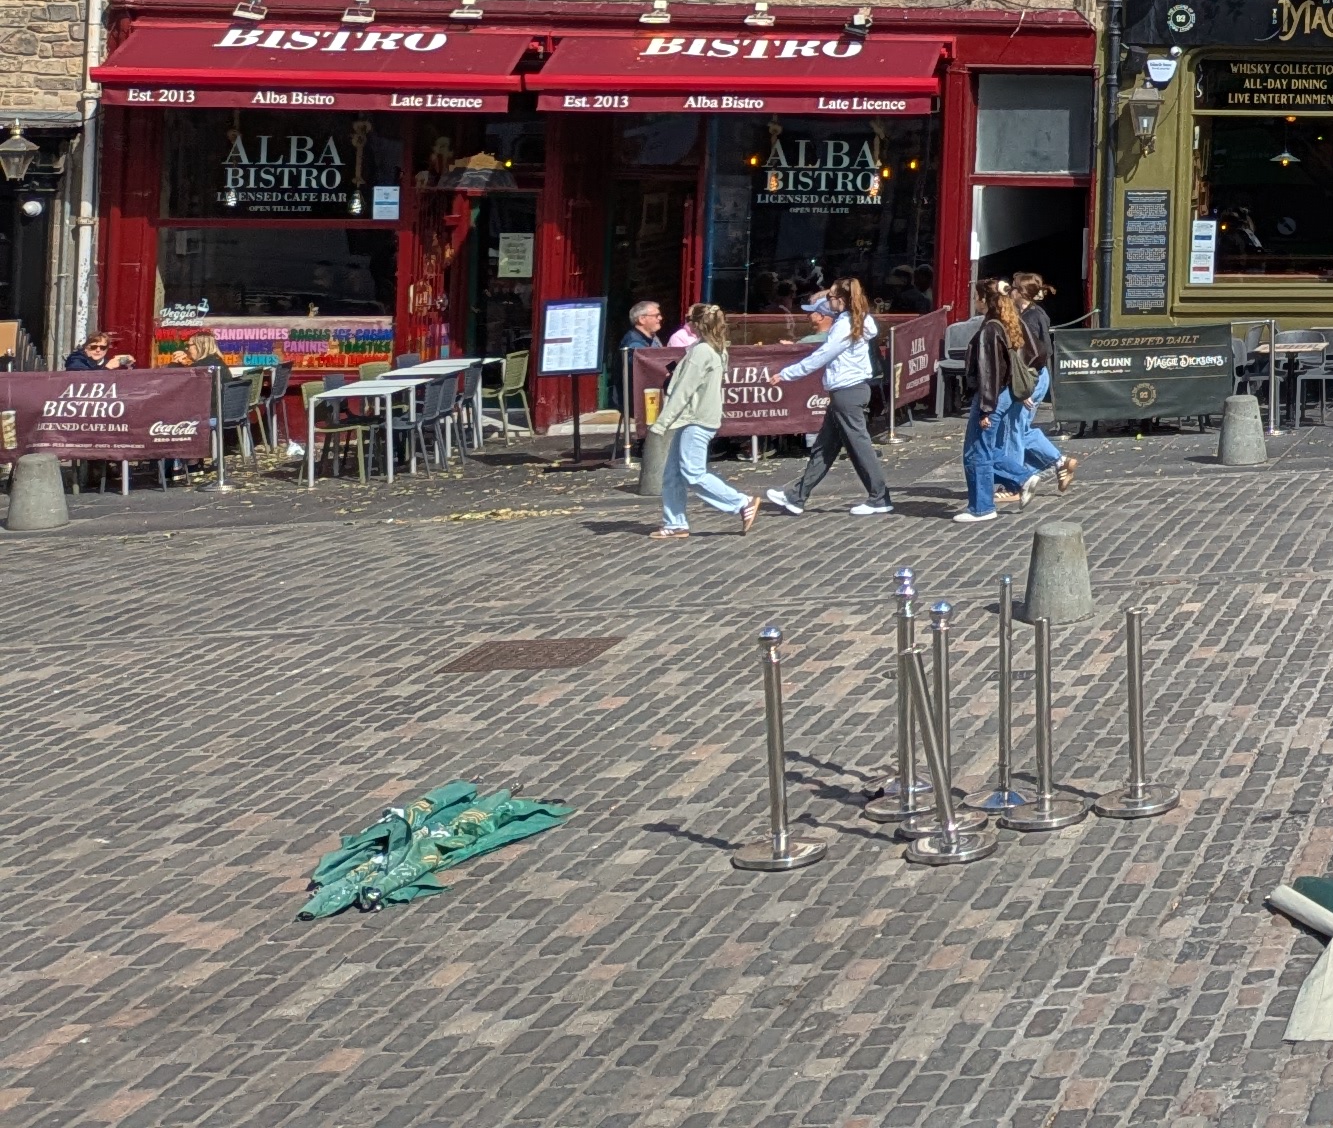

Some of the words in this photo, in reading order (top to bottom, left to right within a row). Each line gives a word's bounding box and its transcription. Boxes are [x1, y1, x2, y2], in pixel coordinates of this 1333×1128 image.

[211, 29, 448, 52] BISTRO
[638, 37, 864, 59] BISTRO
[1230, 63, 1271, 75] WHISKY
[1243, 78, 1289, 89] ALL-DAY
[1291, 79, 1328, 90] DINING
[127, 89, 155, 102] Est.
[158, 89, 196, 103] 2013
[251, 91, 288, 104] Alba
[290, 92, 335, 105] Bistro
[390, 93, 423, 107] Late
[425, 95, 483, 108] Licence
[563, 95, 590, 108] Est.
[593, 96, 629, 108] 2013
[683, 96, 718, 109] Alba
[721, 97, 764, 109] Bistro
[1228, 92, 1251, 104] LIVE
[818, 97, 850, 110] Late
[853, 98, 907, 110] Licence
[221, 135, 346, 166] ALBA
[761, 138, 880, 170] ALBA
[224, 167, 342, 189] BISTRO
[763, 170, 878, 192] BISTRO
[284, 192, 318, 203] CAFE
[320, 192, 347, 203] BAR
[757, 194, 819, 204] LICENSED
[821, 194, 853, 204] CAFE
[856, 195, 882, 205] BAR
[160, 307, 196, 320] Veggie
[214, 328, 289, 340] SANDWICHES
[283, 340, 329, 353] PANINIS
[910, 337, 926, 356] ALBA
[1090, 338, 1119, 347] FOOD
[1120, 336, 1164, 347] SERVED
[243, 354, 280, 366] CAKES
[1059, 358, 1089, 369] INNIS
[1091, 357, 1100, 368] &
[1101, 357, 1132, 368] GUNN
[1145, 355, 1179, 371] MAGGIE
[721, 366, 772, 385] ALBA
[58, 382, 118, 399] ALBA
[721, 385, 783, 405] ISTRO
[42, 400, 125, 418] BISTRO
[745, 409, 768, 418] CAFE
[769, 408, 789, 417] BAR
[36, 423, 80, 432] LICENSED
[81, 423, 107, 432] CAFE
[108, 423, 129, 432] BAR
[149, 420, 200, 436] Coca-Cola
